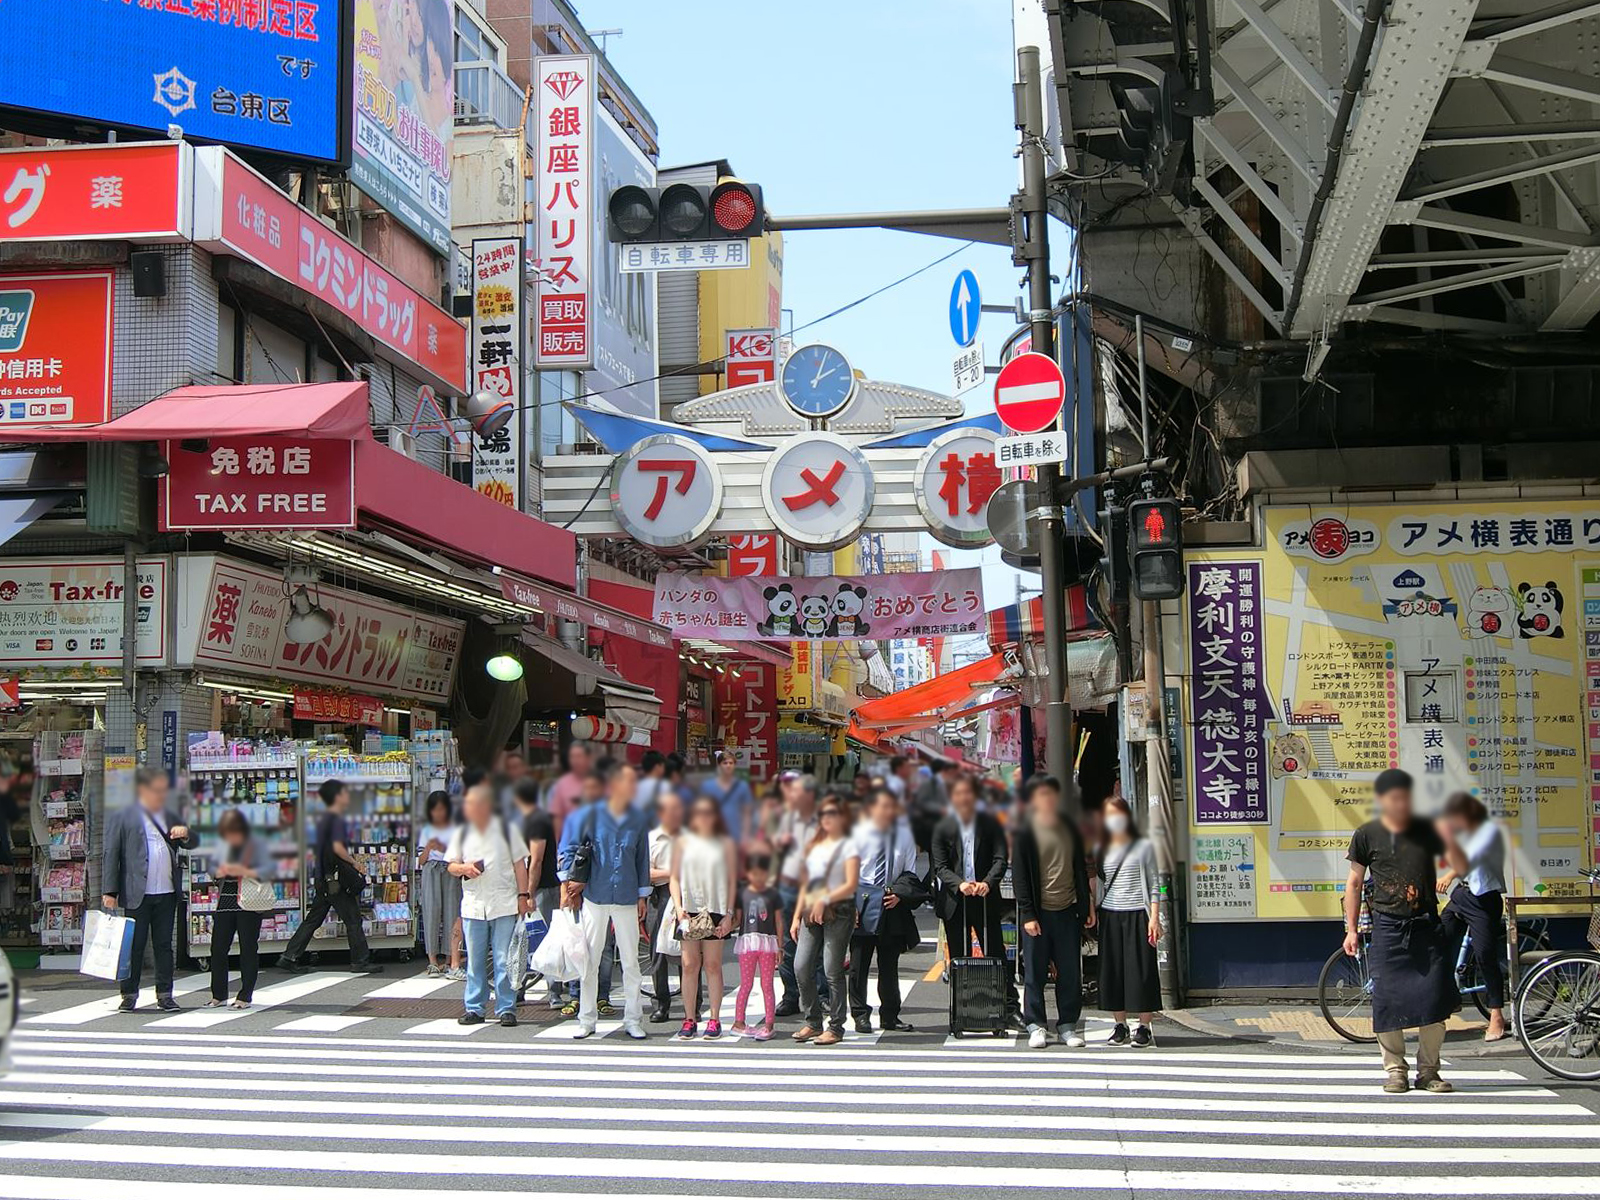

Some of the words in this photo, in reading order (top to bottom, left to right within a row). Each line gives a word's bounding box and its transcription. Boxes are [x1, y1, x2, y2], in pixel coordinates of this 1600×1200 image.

[277, 54, 318, 78] です
[211, 87, 292, 125] 台東区
[4, 163, 51, 229] グ
[90, 176, 124, 210] 薬
[546, 106, 582, 285] 銀座パリス
[236, 192, 282, 250] 化粧品
[476, 245, 515, 267] 24時間
[628, 243, 744, 266] 自転車専用
[300, 226, 416, 346] コクミンドラッグ
[543, 300, 584, 321] 買取
[543, 332, 584, 353] 販売
[15, 385, 62, 396] Accepted
[478, 323, 513, 455] 一軒め場
[211, 447, 311, 475] 免税店
[1000, 440, 1063, 462] 自転車を除く
[637, 451, 1001, 522] アメ横
[195, 494, 248, 514] TAX
[257, 493, 327, 513] FREE
[1402, 518, 1600, 549] アメ横表通り
[50, 580, 154, 601] Tax-fre
[513, 584, 540, 607] Tax-free
[659, 589, 718, 605] パンダの
[207, 582, 242, 645] 薬
[248, 600, 277, 619] Kanebo
[873, 590, 981, 618] おめでとう
[658, 608, 748, 628] 赤ちゃん誕生
[893, 621, 978, 636] アメ横商店街連合会
[10, 627, 28, 636] doors
[59, 627, 88, 635] Welcome
[89, 627, 97, 635] to
[1239, 568, 1256, 691] 開運勝利の守護神
[427, 630, 457, 653] Tax-free
[239, 644, 268, 661] SOFINA
[1288, 652, 1349, 660] ロンドンスポーツ
[1306, 663, 1350, 671] シルクロード
[1195, 566, 1242, 809] 摩利支天徳大寺
[1311, 682, 1350, 690] 上野アメ横
[788, 696, 807, 706] 入口
[1338, 701, 1385, 709] カワチヤ食品
[1543, 715, 1575, 723] アメ横店
[1242, 698, 1260, 808] 毎月亥の日縁日
[1479, 749, 1542, 758] ロンドンスポーツ
[1479, 762, 1525, 771] シルクロード
[1200, 810, 1265, 820] ココより徒歩30秒
[1540, 859, 1571, 867] 春日通り
